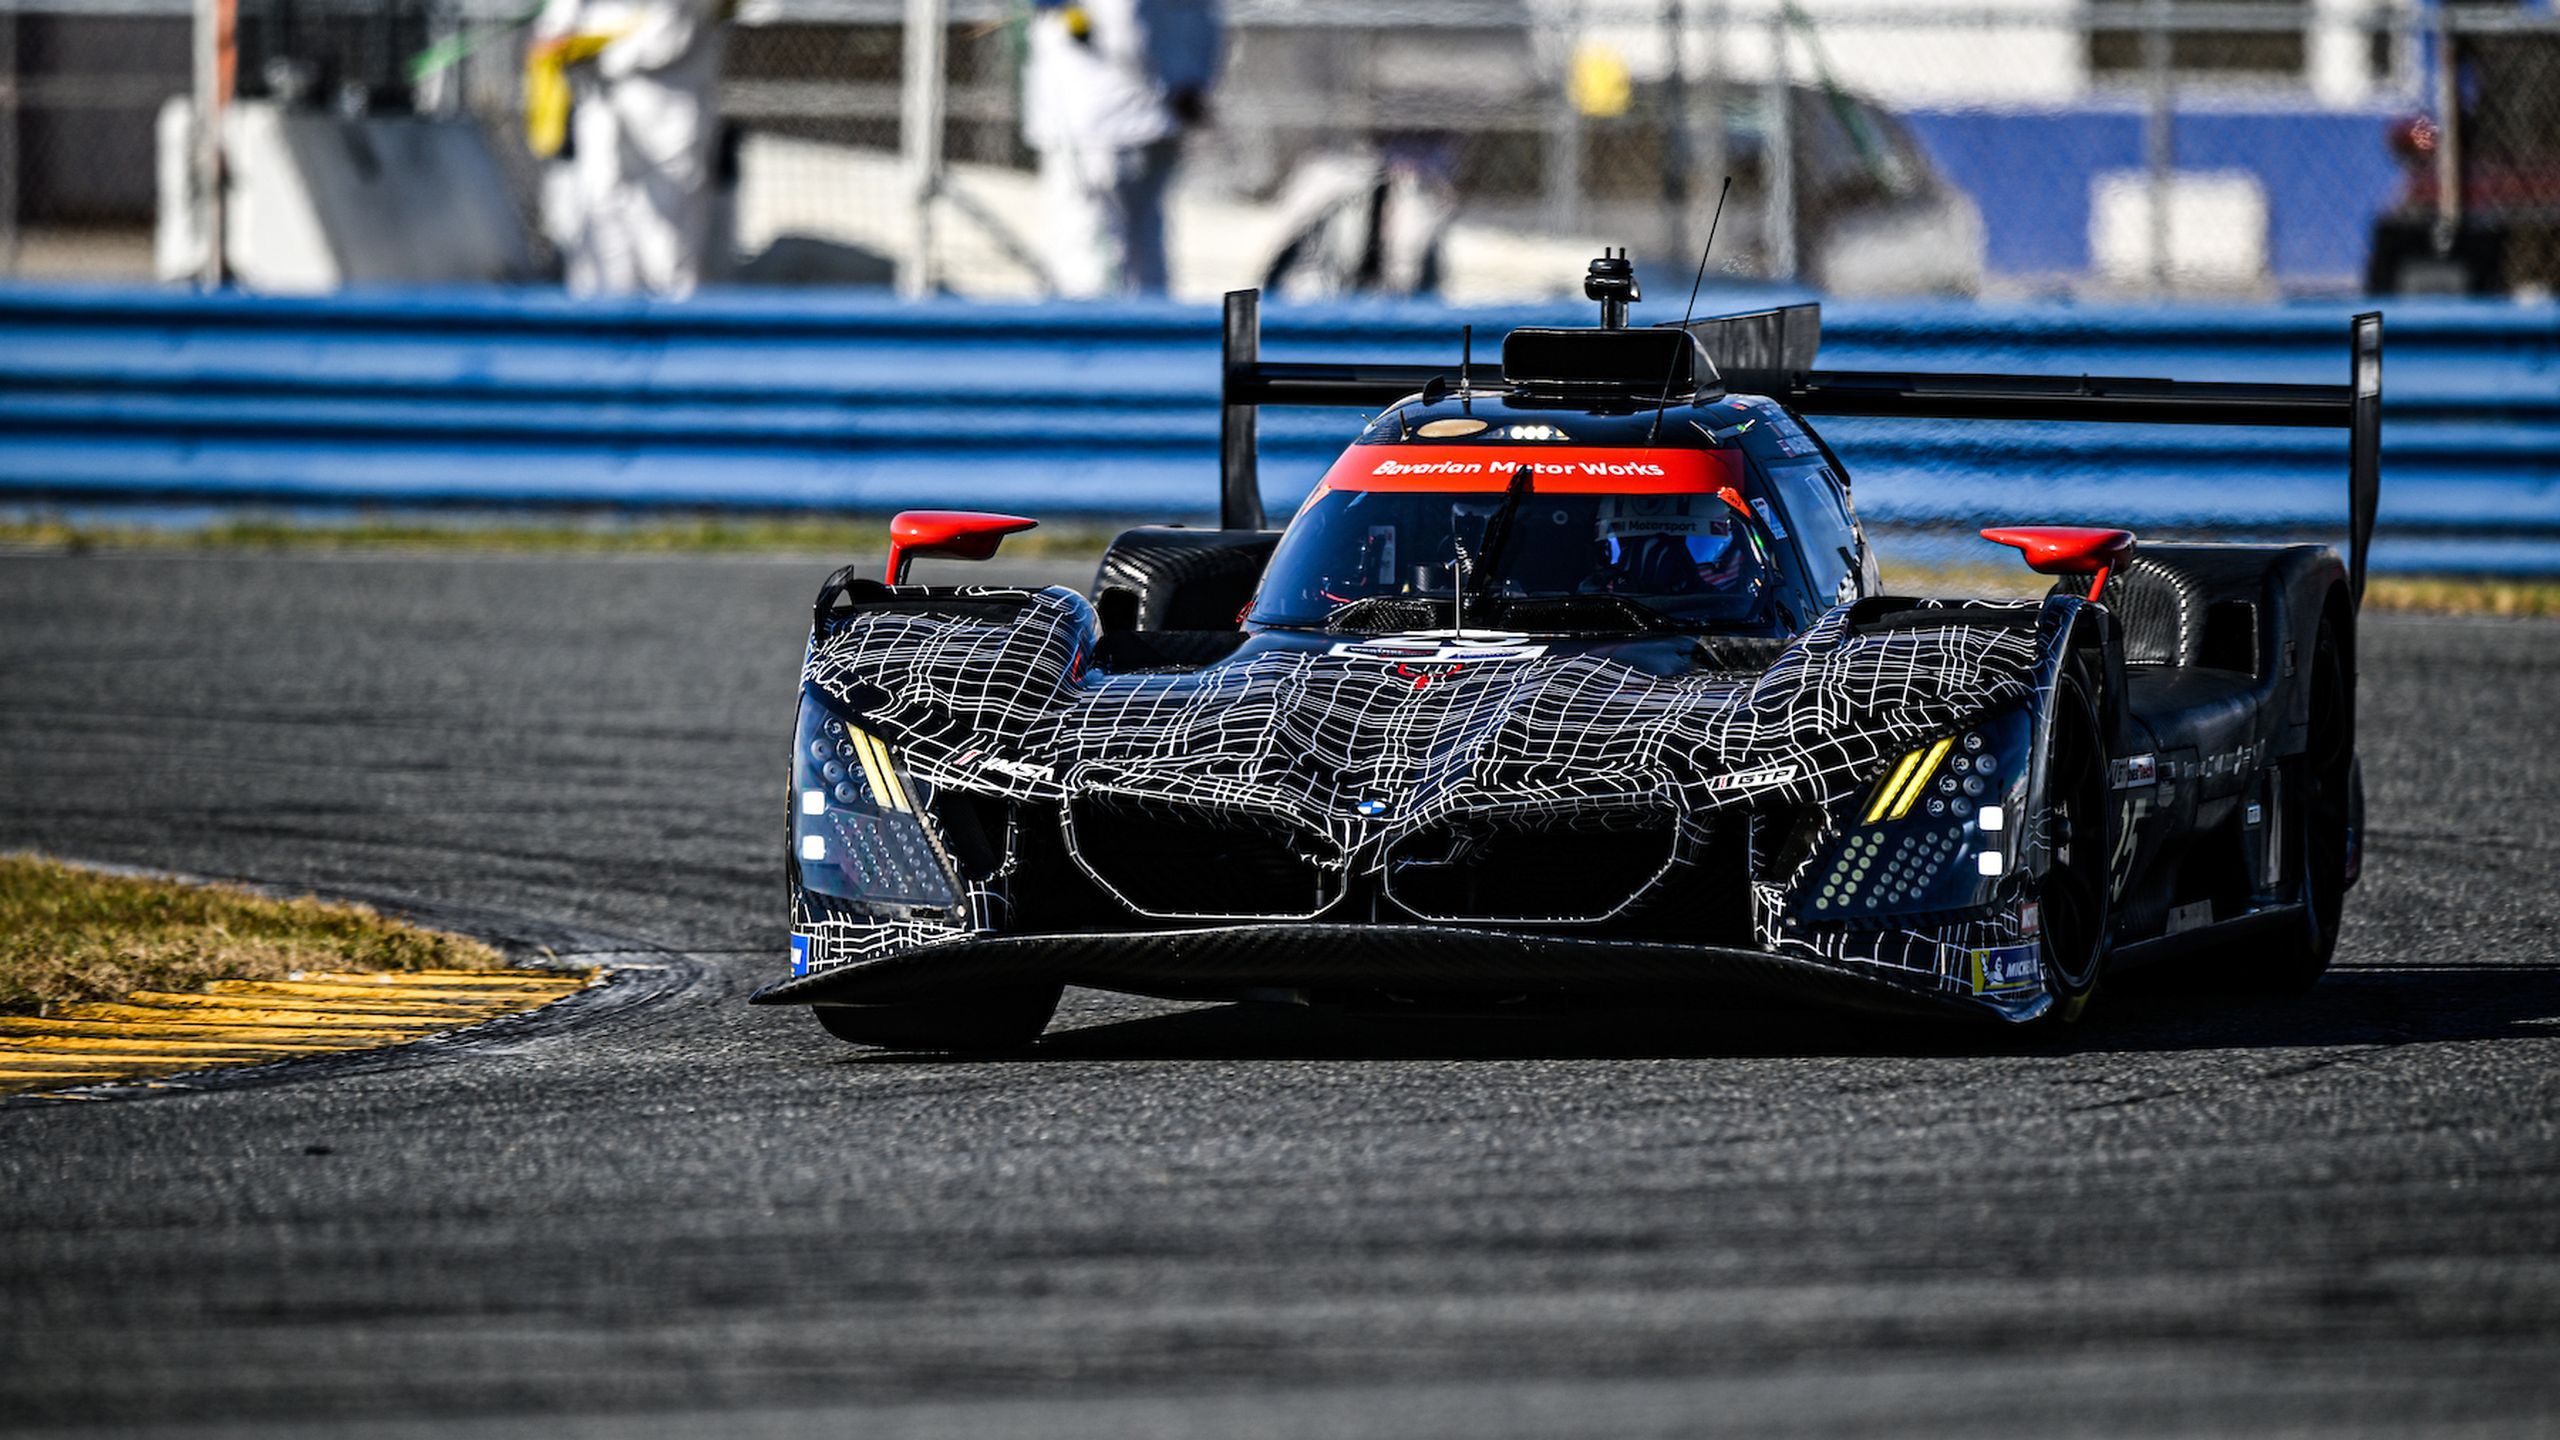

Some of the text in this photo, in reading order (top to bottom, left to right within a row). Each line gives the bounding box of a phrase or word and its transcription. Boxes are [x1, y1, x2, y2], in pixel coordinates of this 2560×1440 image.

[1372, 460, 1482, 475] Bavarian
[1578, 462, 1665, 476] Works
[1629, 520, 1697, 532] Motorsport
[979, 757, 1054, 781] IMSA
[1738, 769, 1790, 784] GTP
